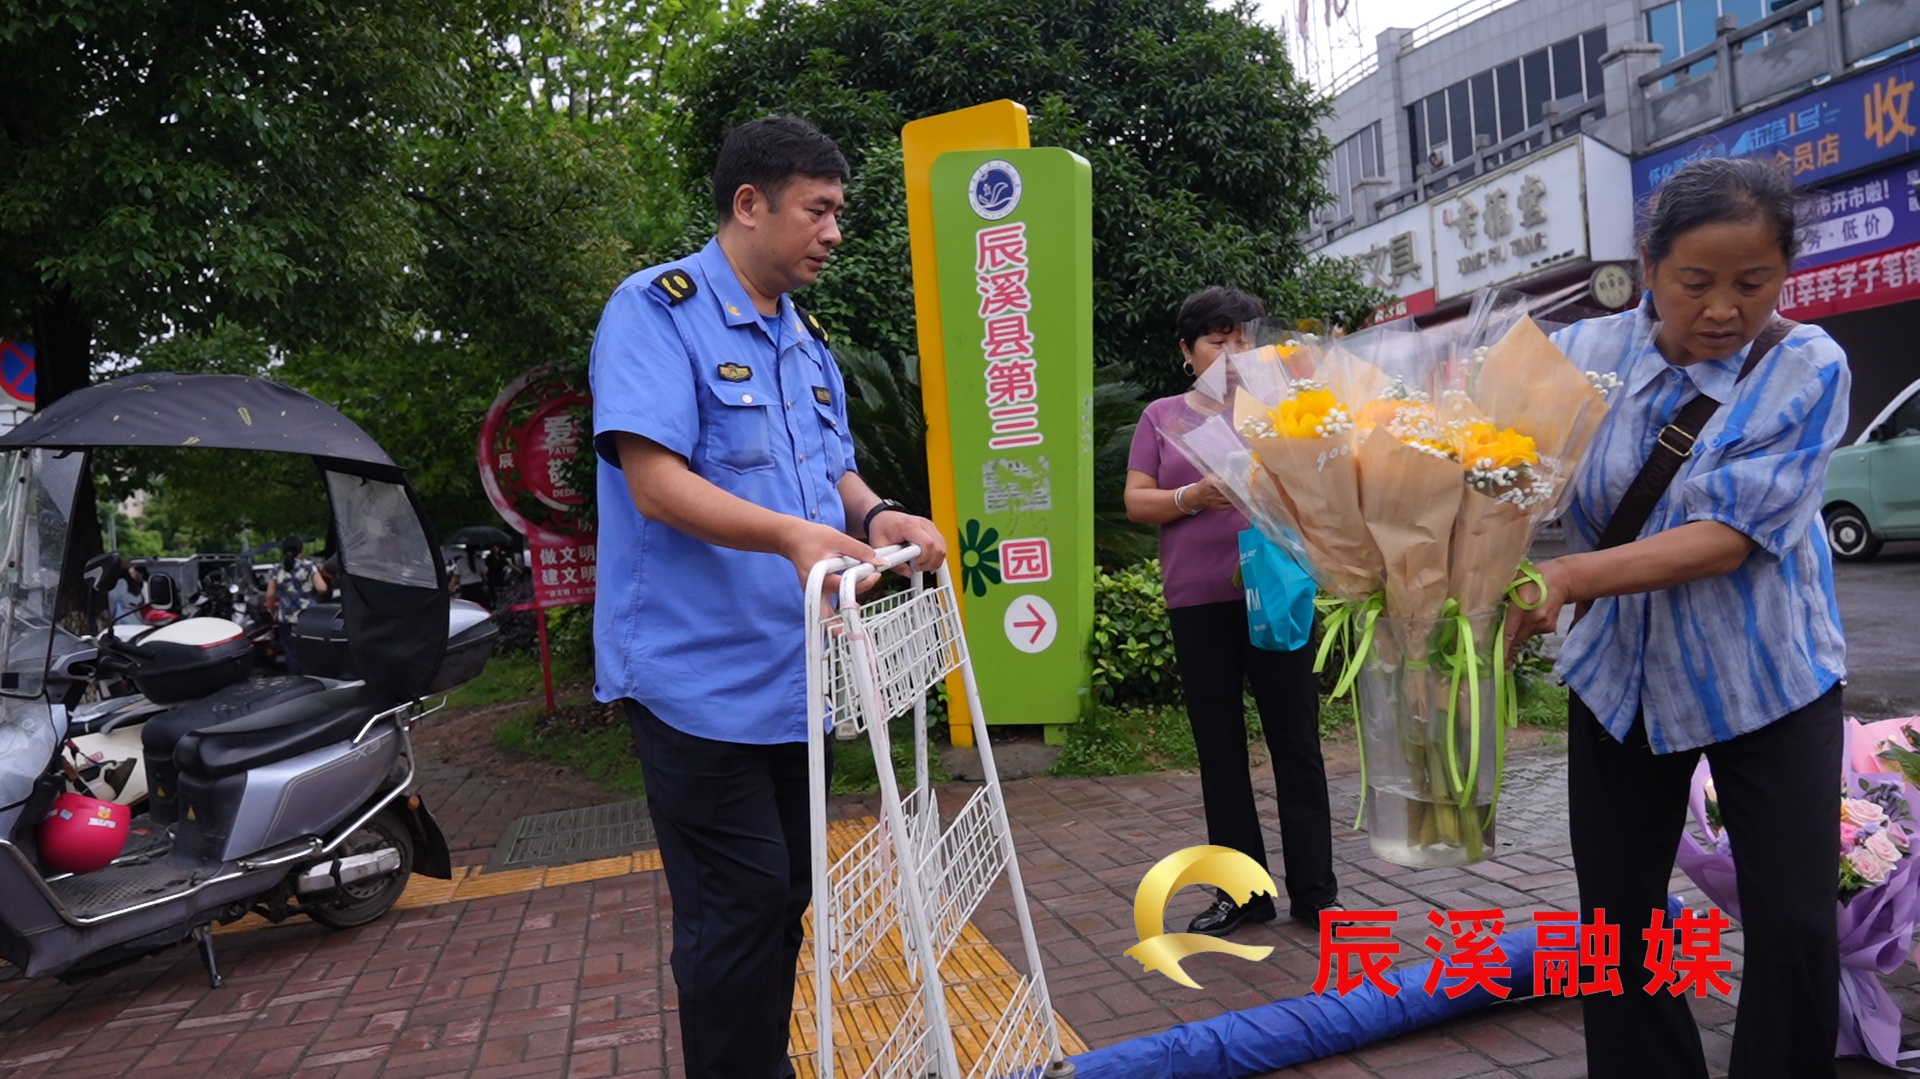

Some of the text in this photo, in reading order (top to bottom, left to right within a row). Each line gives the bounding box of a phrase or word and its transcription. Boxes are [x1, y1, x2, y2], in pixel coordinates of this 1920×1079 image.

[1864, 77, 1917, 148] 收
[974, 221, 1044, 450] 辰溪县第三
[999, 537, 1052, 584] 园
